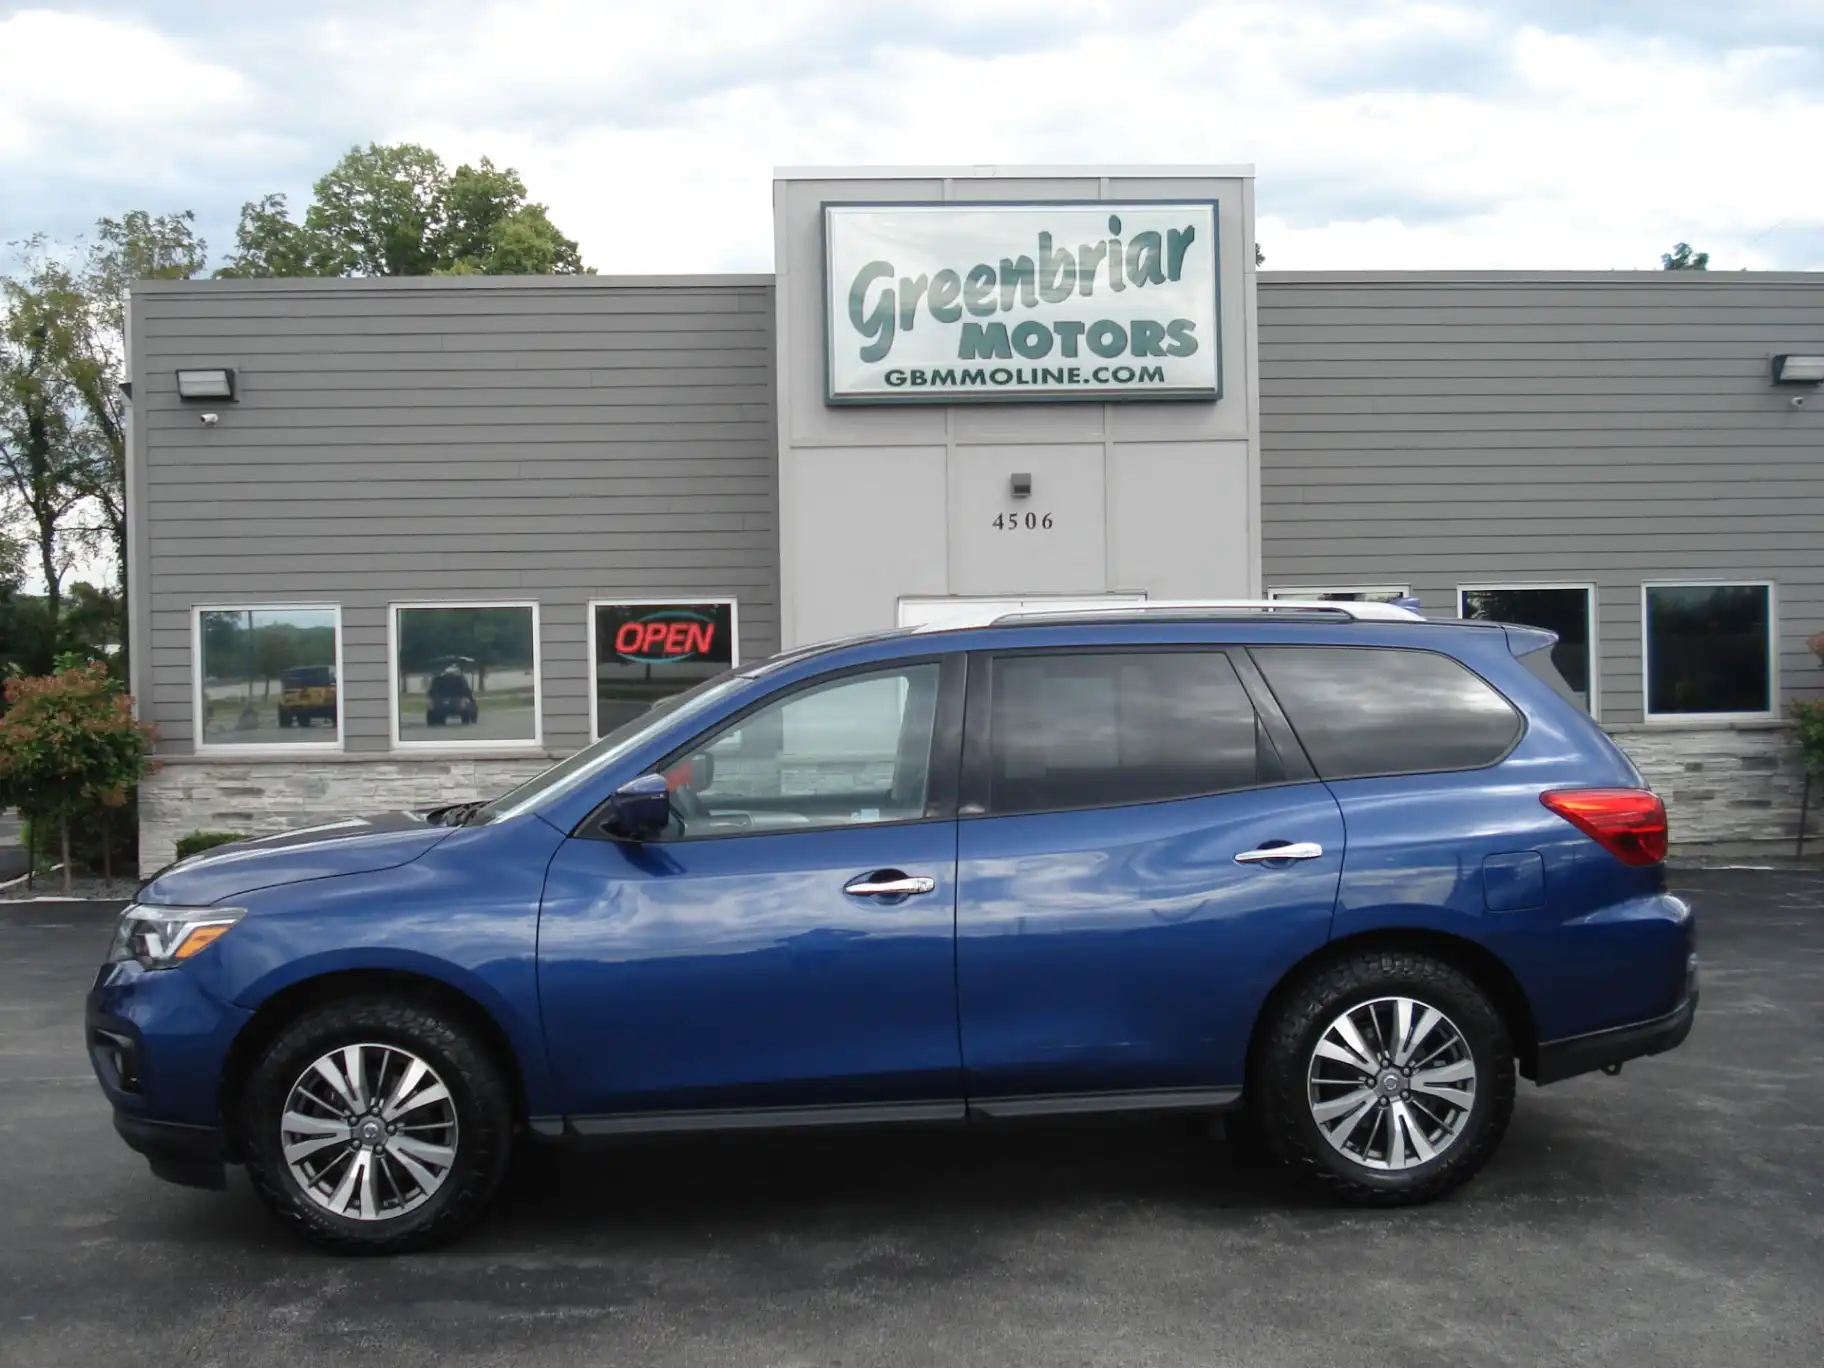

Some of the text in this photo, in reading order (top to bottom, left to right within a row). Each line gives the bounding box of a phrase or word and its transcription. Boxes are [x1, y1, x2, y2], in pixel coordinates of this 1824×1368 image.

[848, 215, 1195, 363] Greenbriar
[958, 319, 1199, 360] MOTORS
[884, 365, 1165, 387] GBMMOLINE.COM
[992, 512, 1053, 531] 4506
[615, 621, 715, 653] OPEN
